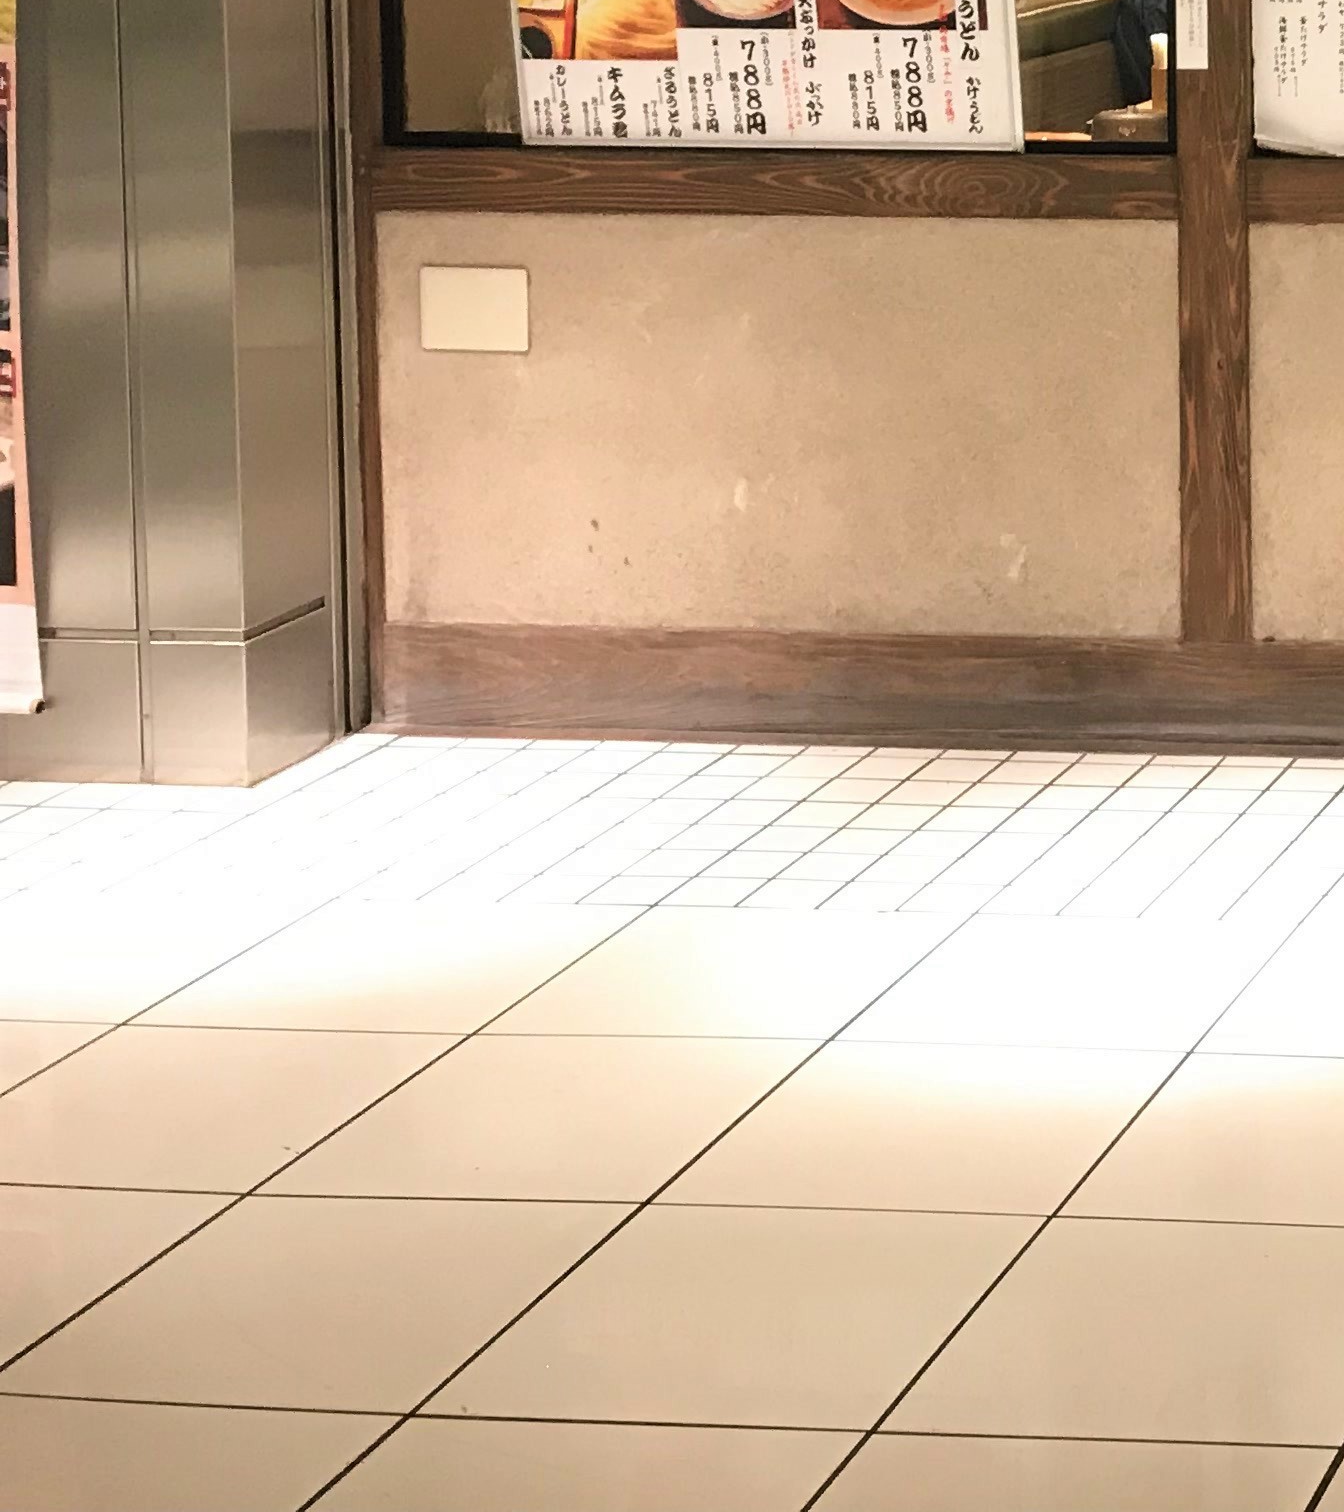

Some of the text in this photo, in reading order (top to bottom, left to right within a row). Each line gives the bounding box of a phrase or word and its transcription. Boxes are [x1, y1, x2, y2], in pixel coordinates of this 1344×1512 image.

[703, 72, 719, 133] 815円
[740, 40, 767, 134] 788円
[806, 82, 824, 126] ぶっかけ
[863, 70, 880, 131] 815円
[902, 37, 927, 133] 788円
[966, 76, 983, 134] かけうどん
